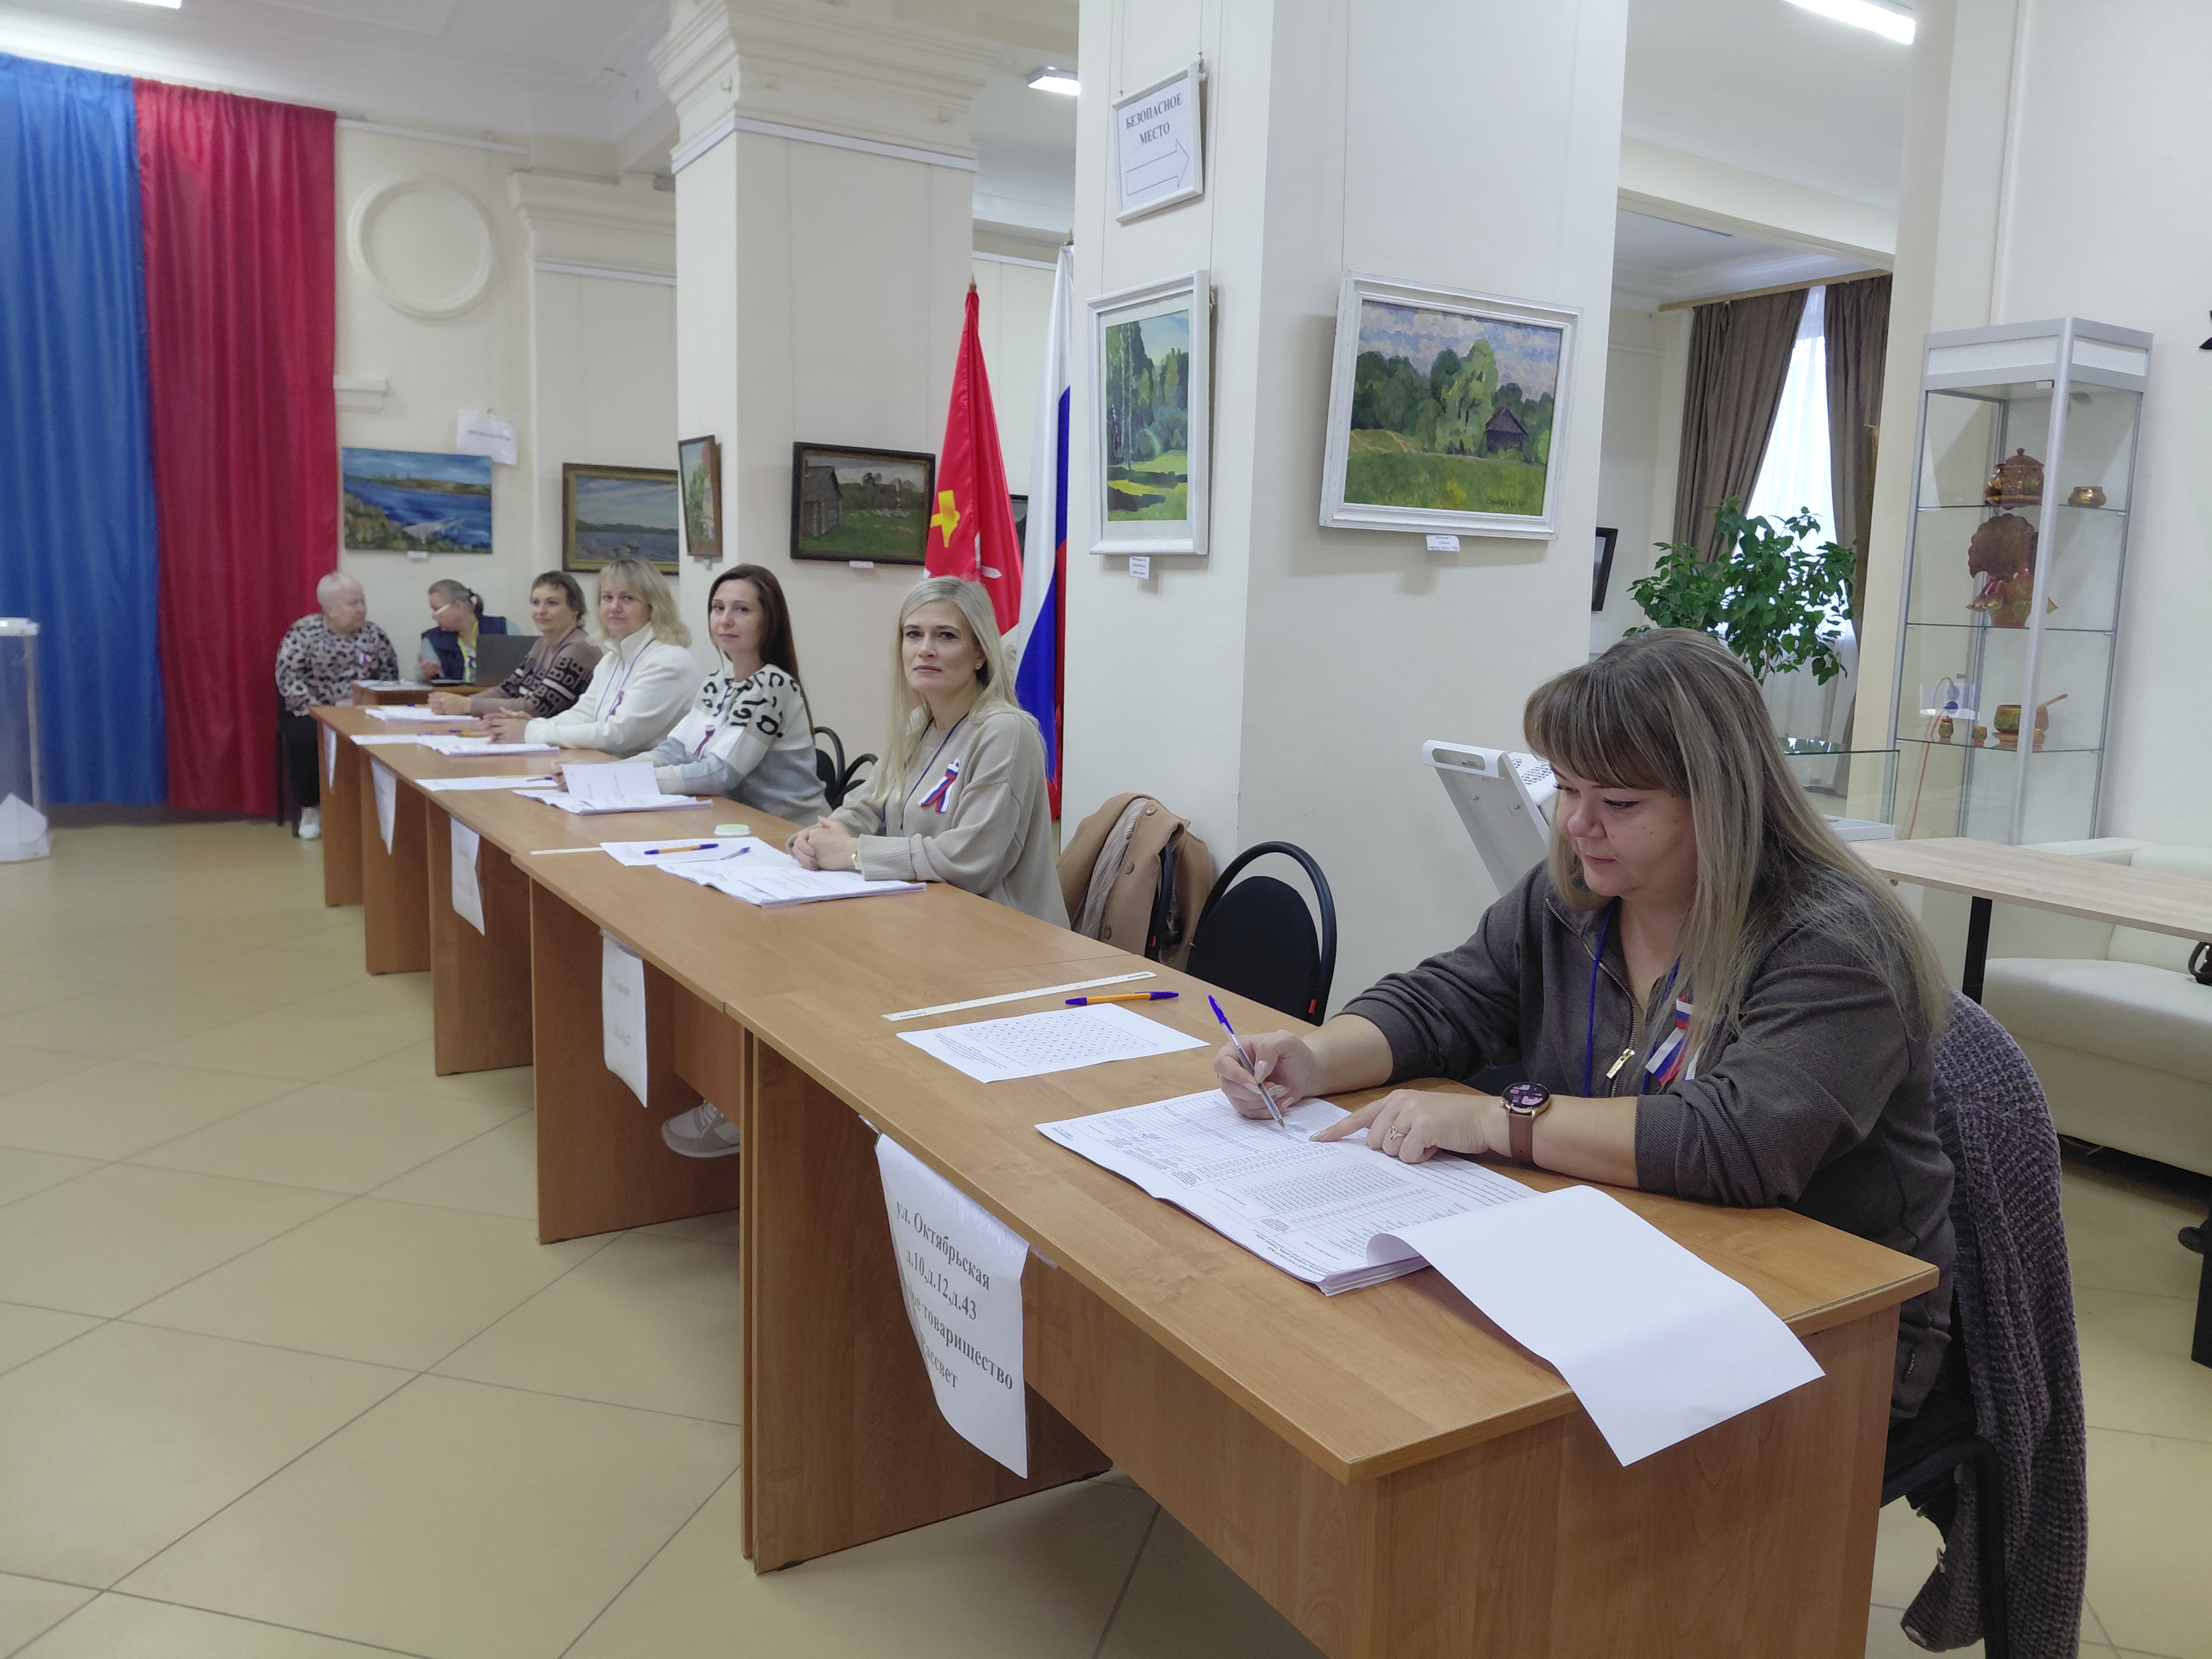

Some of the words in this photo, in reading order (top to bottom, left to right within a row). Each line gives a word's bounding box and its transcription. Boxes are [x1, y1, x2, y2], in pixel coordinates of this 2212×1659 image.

[1126, 93, 1183, 130] БЕЗОПАСНОЕ
[1139, 122, 1171, 146] МЕСТО
[896, 1201, 911, 1225] ул.
[914, 1212, 990, 1291] Октябрьская
[922, 1303, 1013, 1390] товарищество
